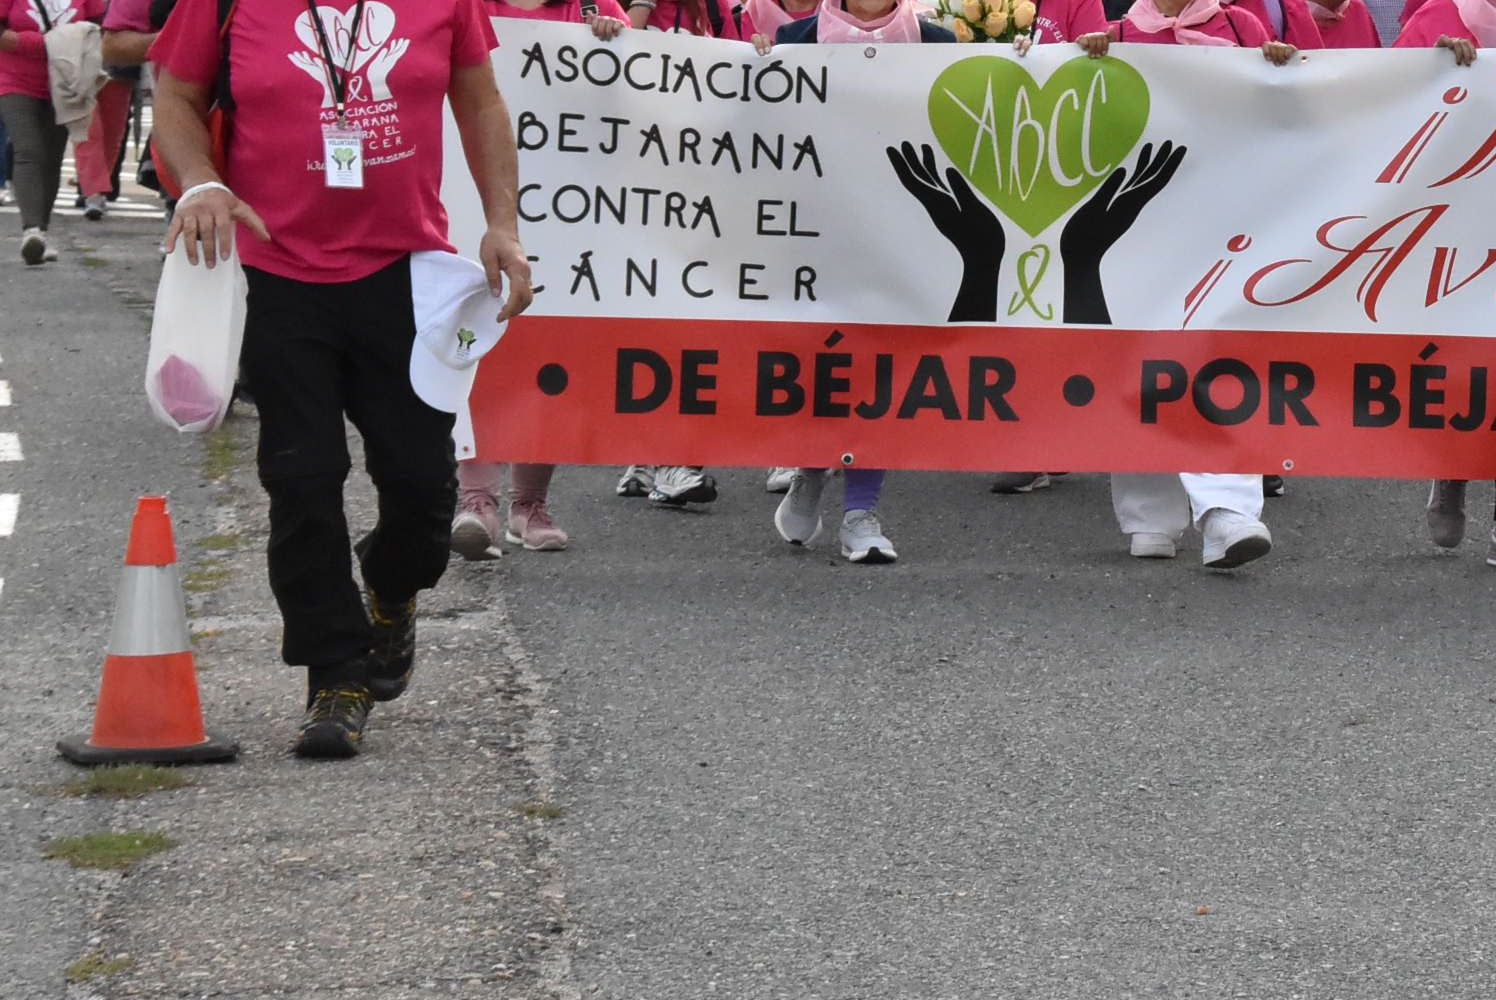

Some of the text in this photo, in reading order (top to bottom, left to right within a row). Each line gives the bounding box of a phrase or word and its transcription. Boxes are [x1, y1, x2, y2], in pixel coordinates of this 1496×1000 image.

[520, 41, 827, 104] ASOCIACIÓN
[517, 111, 823, 178] BEJARANA
[943, 68, 1112, 201] ABCC
[516, 183, 820, 238] CONTRA EL
[615, 348, 719, 415] DE
[756, 330, 1019, 421] BÉJAR
[1140, 358, 1317, 426] POR
